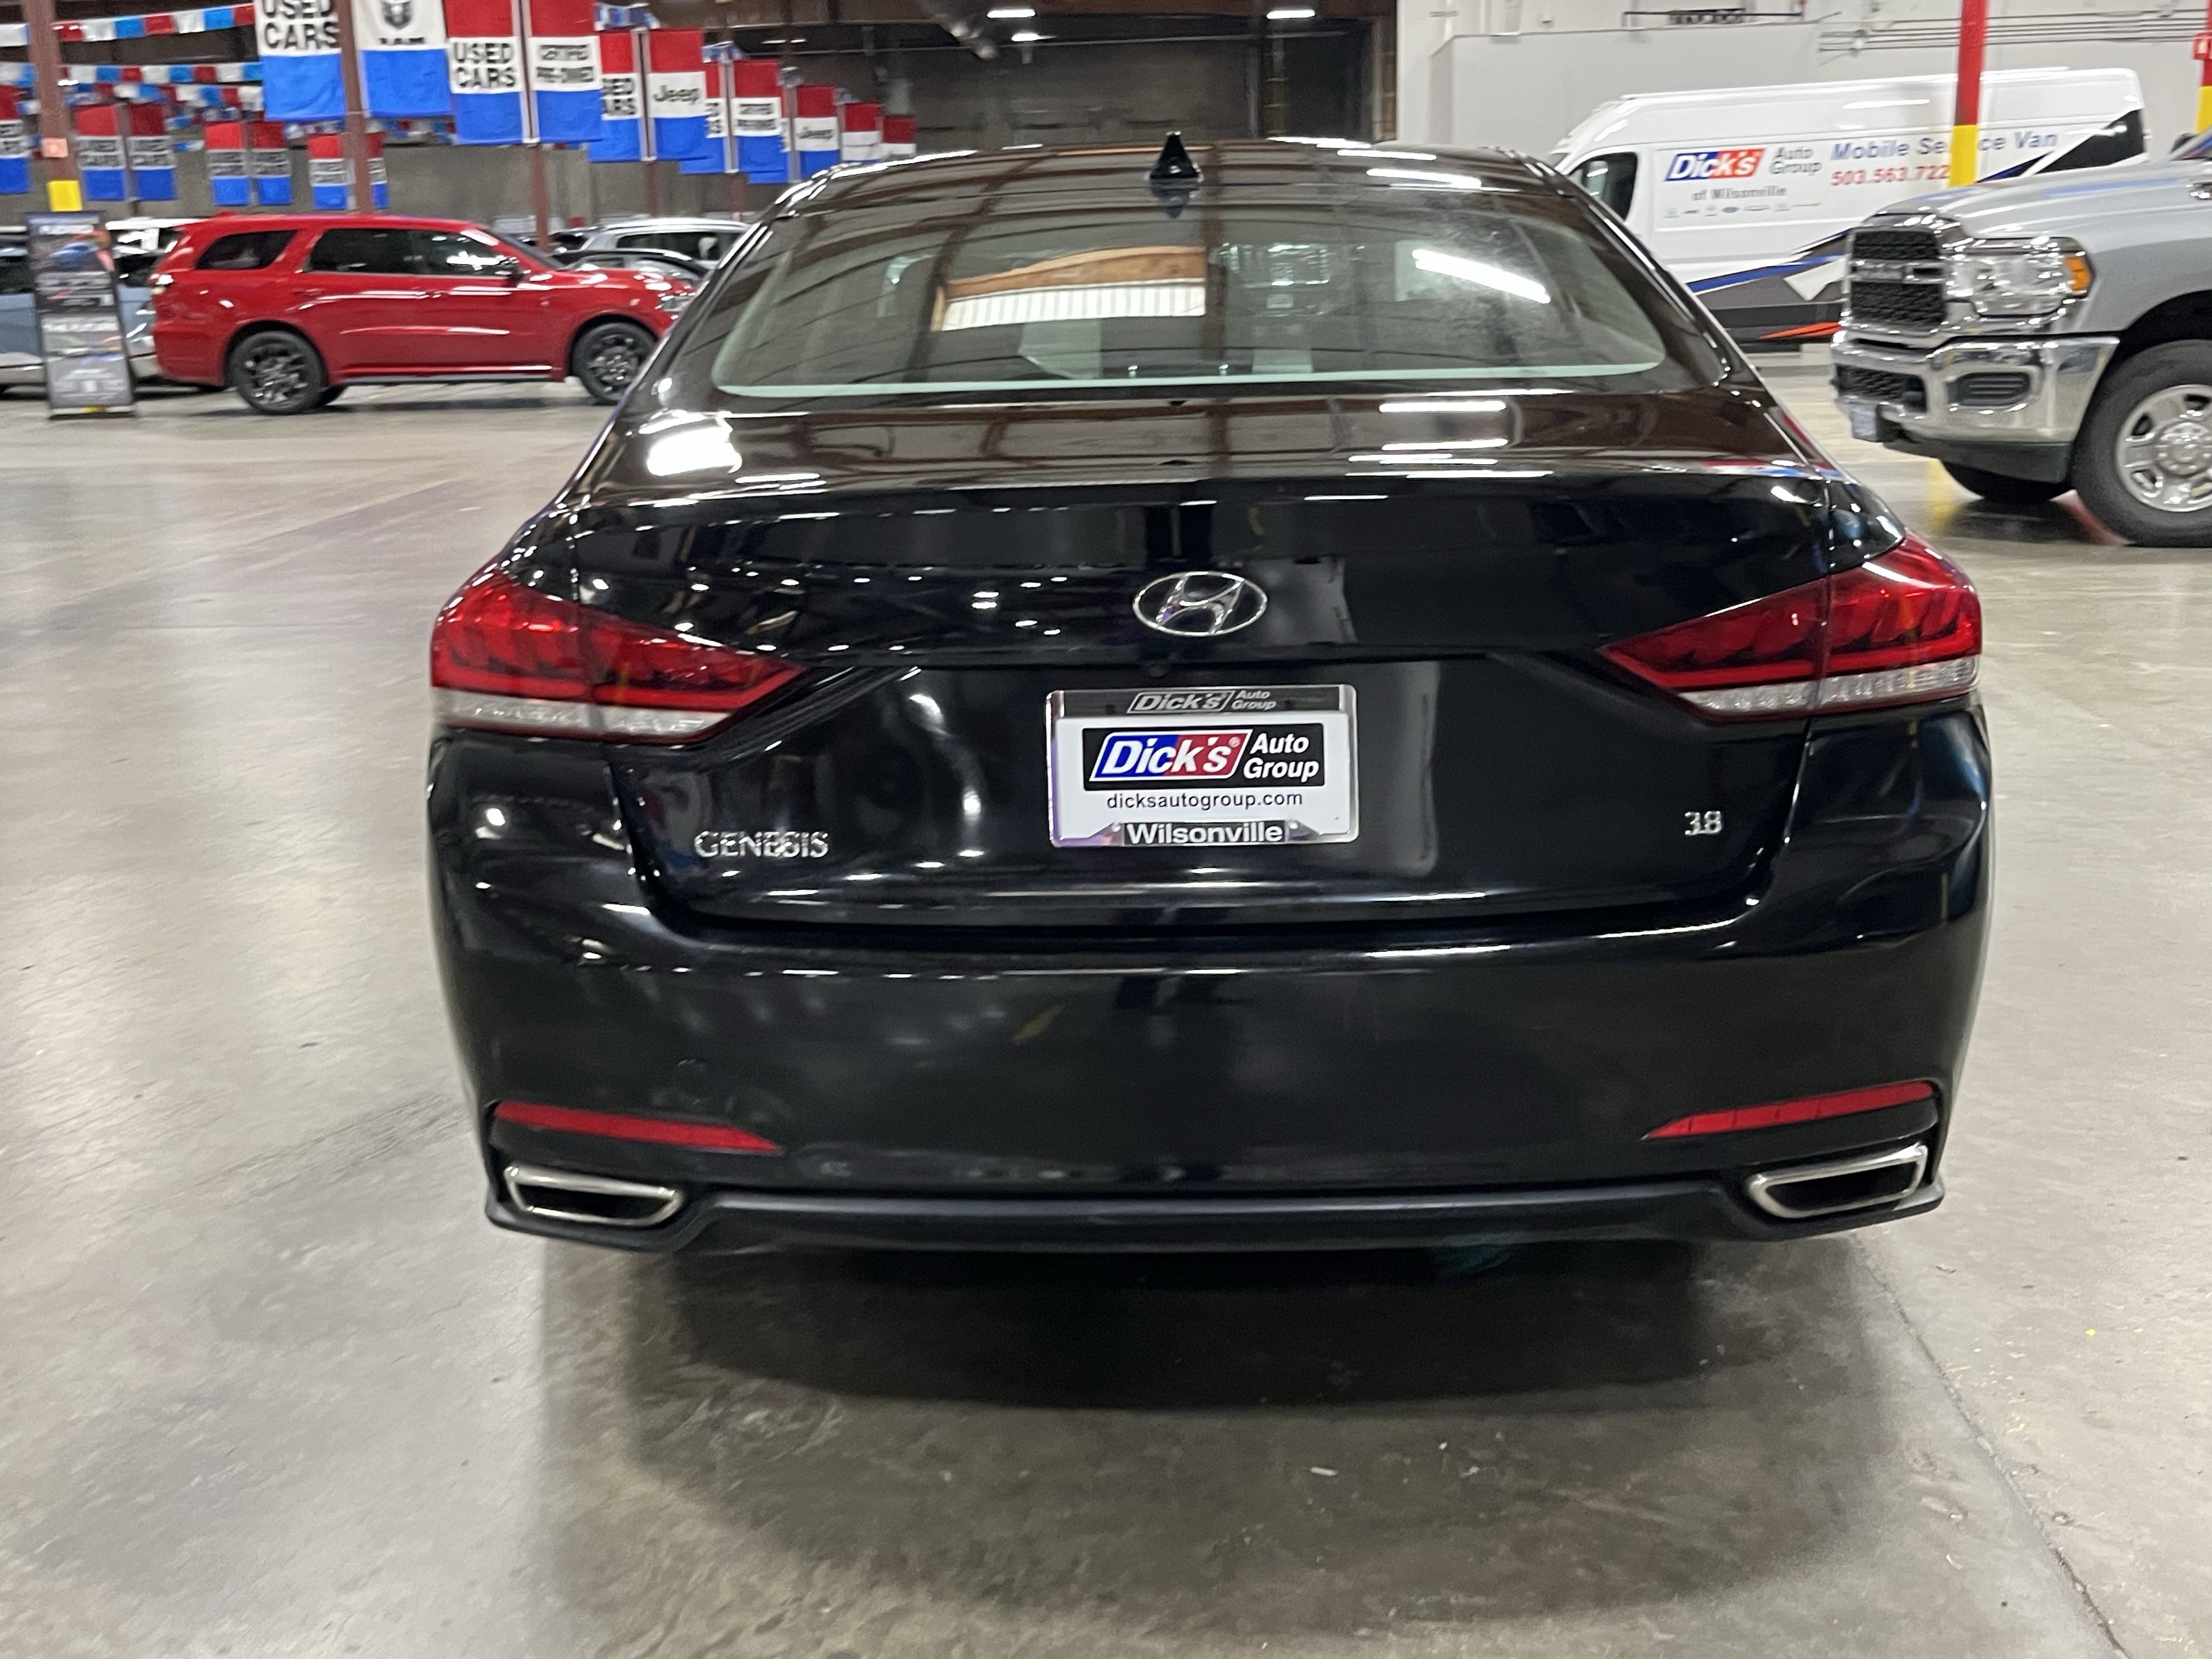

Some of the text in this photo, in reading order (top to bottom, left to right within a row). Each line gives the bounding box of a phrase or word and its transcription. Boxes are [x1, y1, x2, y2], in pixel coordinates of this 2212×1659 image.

[265, 22, 340, 49] CARS
[454, 43, 514, 64] USED
[455, 67, 516, 88] CARS
[653, 85, 700, 105] Jeep
[1774, 146, 1814, 160] Auto
[1831, 131, 2058, 160] Mobile Sece Van
[1668, 150, 1758, 179] Dick's
[1769, 161, 1822, 176] Group
[1136, 692, 1224, 711] Dick's
[1235, 690, 1271, 699] Auto
[1231, 700, 1277, 711] Group
[1249, 733, 1310, 754] Auto
[1243, 757, 1319, 783] Group
[1107, 792, 1302, 810] dicksautogroup.com
[1126, 821, 1283, 844] Wilsonville
[695, 831, 828, 857] GENESIS
